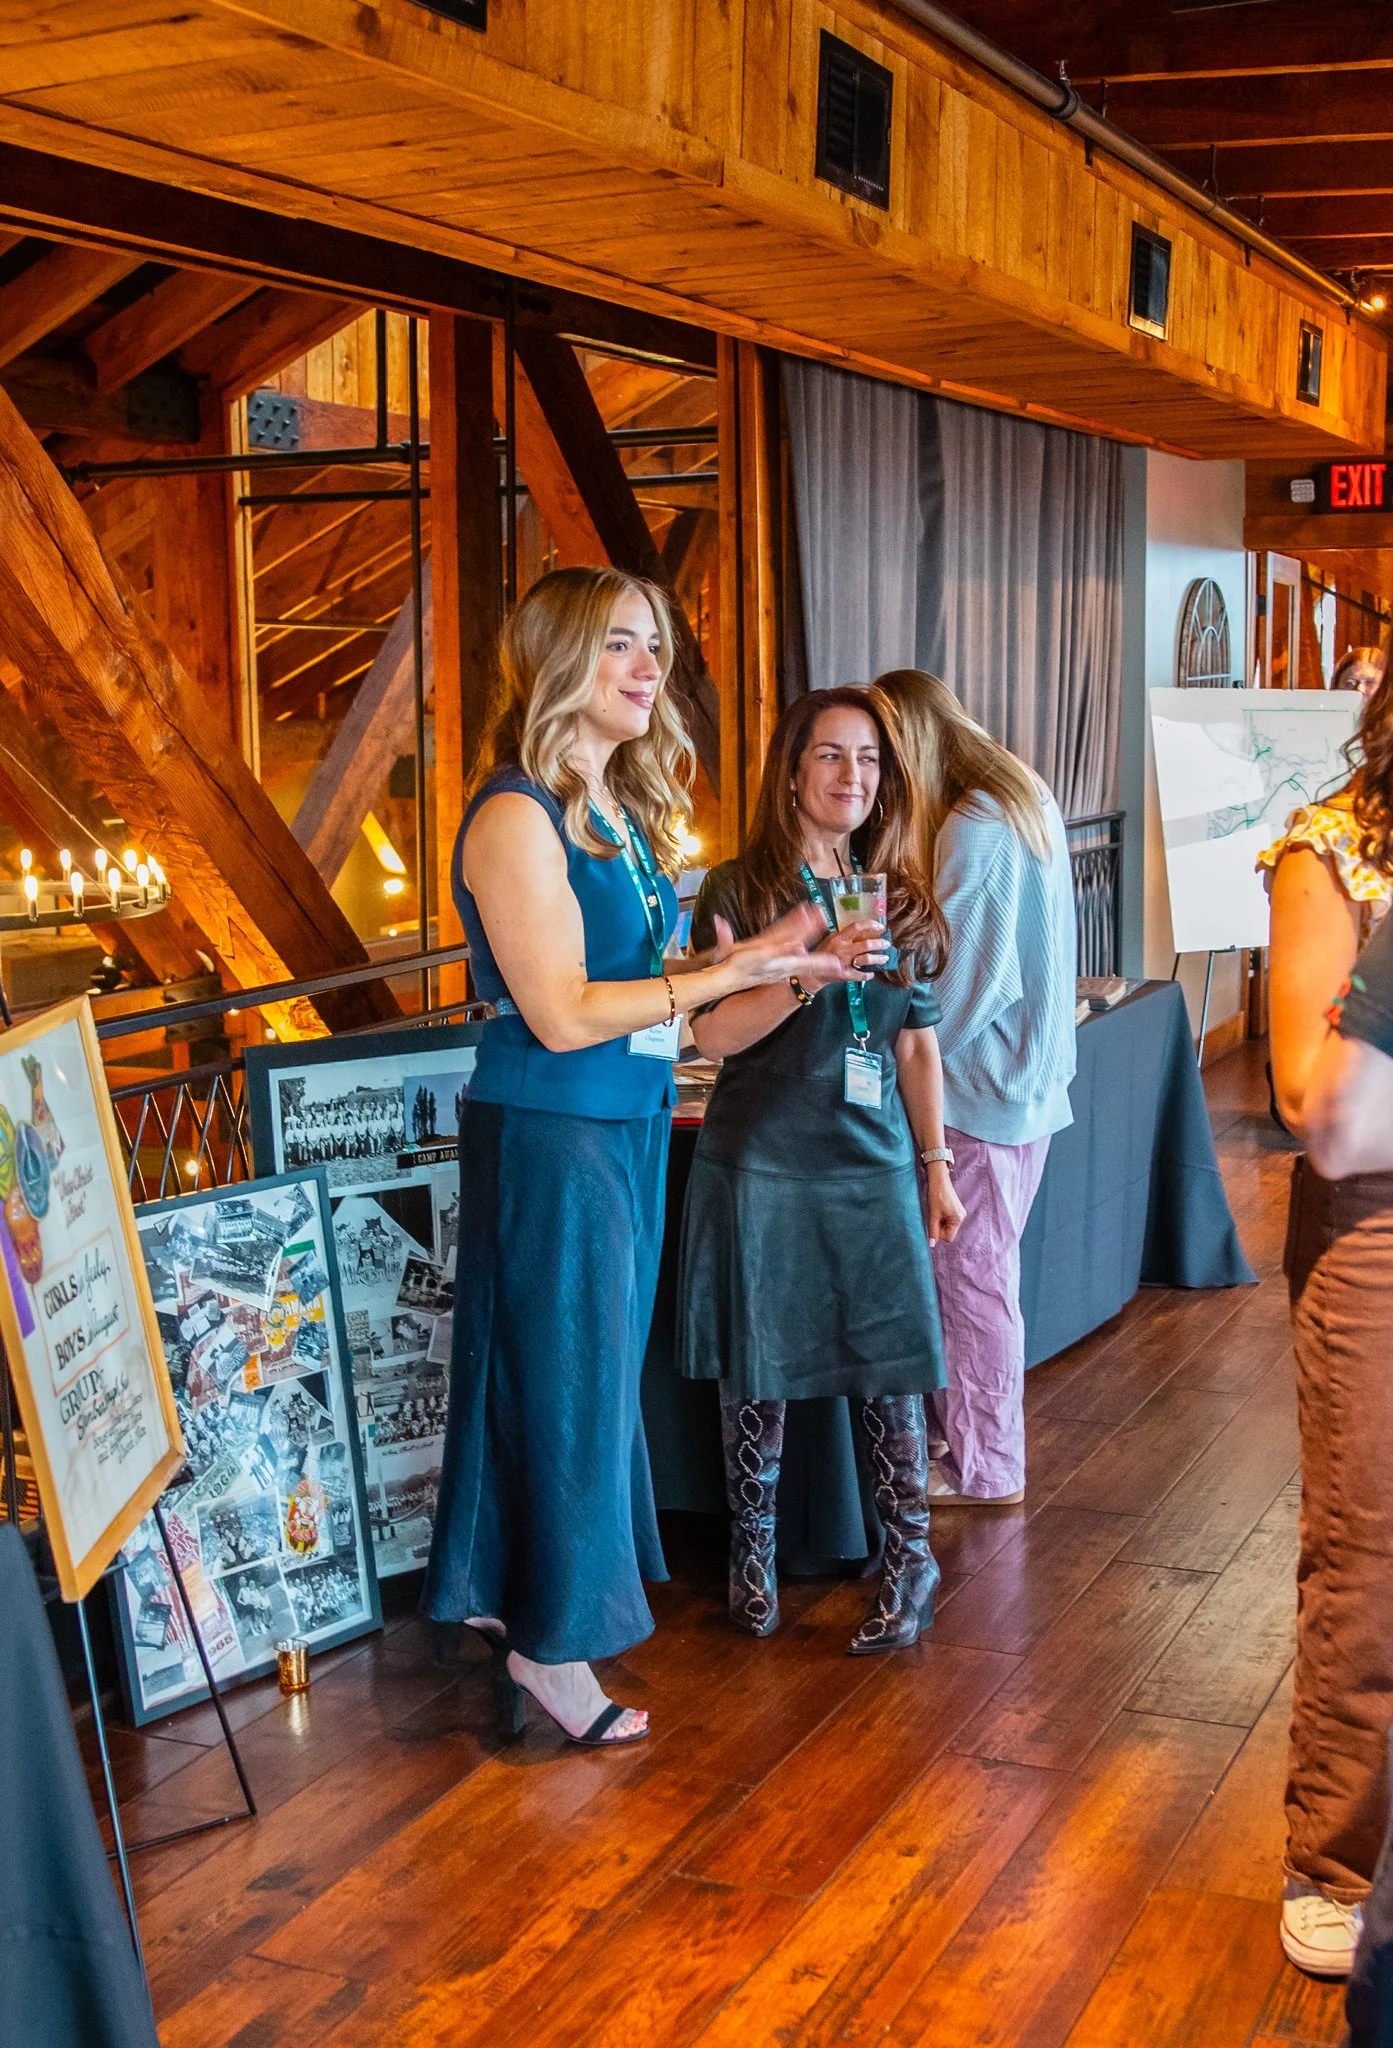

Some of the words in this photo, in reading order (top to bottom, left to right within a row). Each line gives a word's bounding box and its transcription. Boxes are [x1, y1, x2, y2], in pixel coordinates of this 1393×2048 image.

[1331, 464, 1387, 507] EXIT
[43, 1273, 79, 1320] GIRLS
[208, 1464, 238, 1499] 1964
